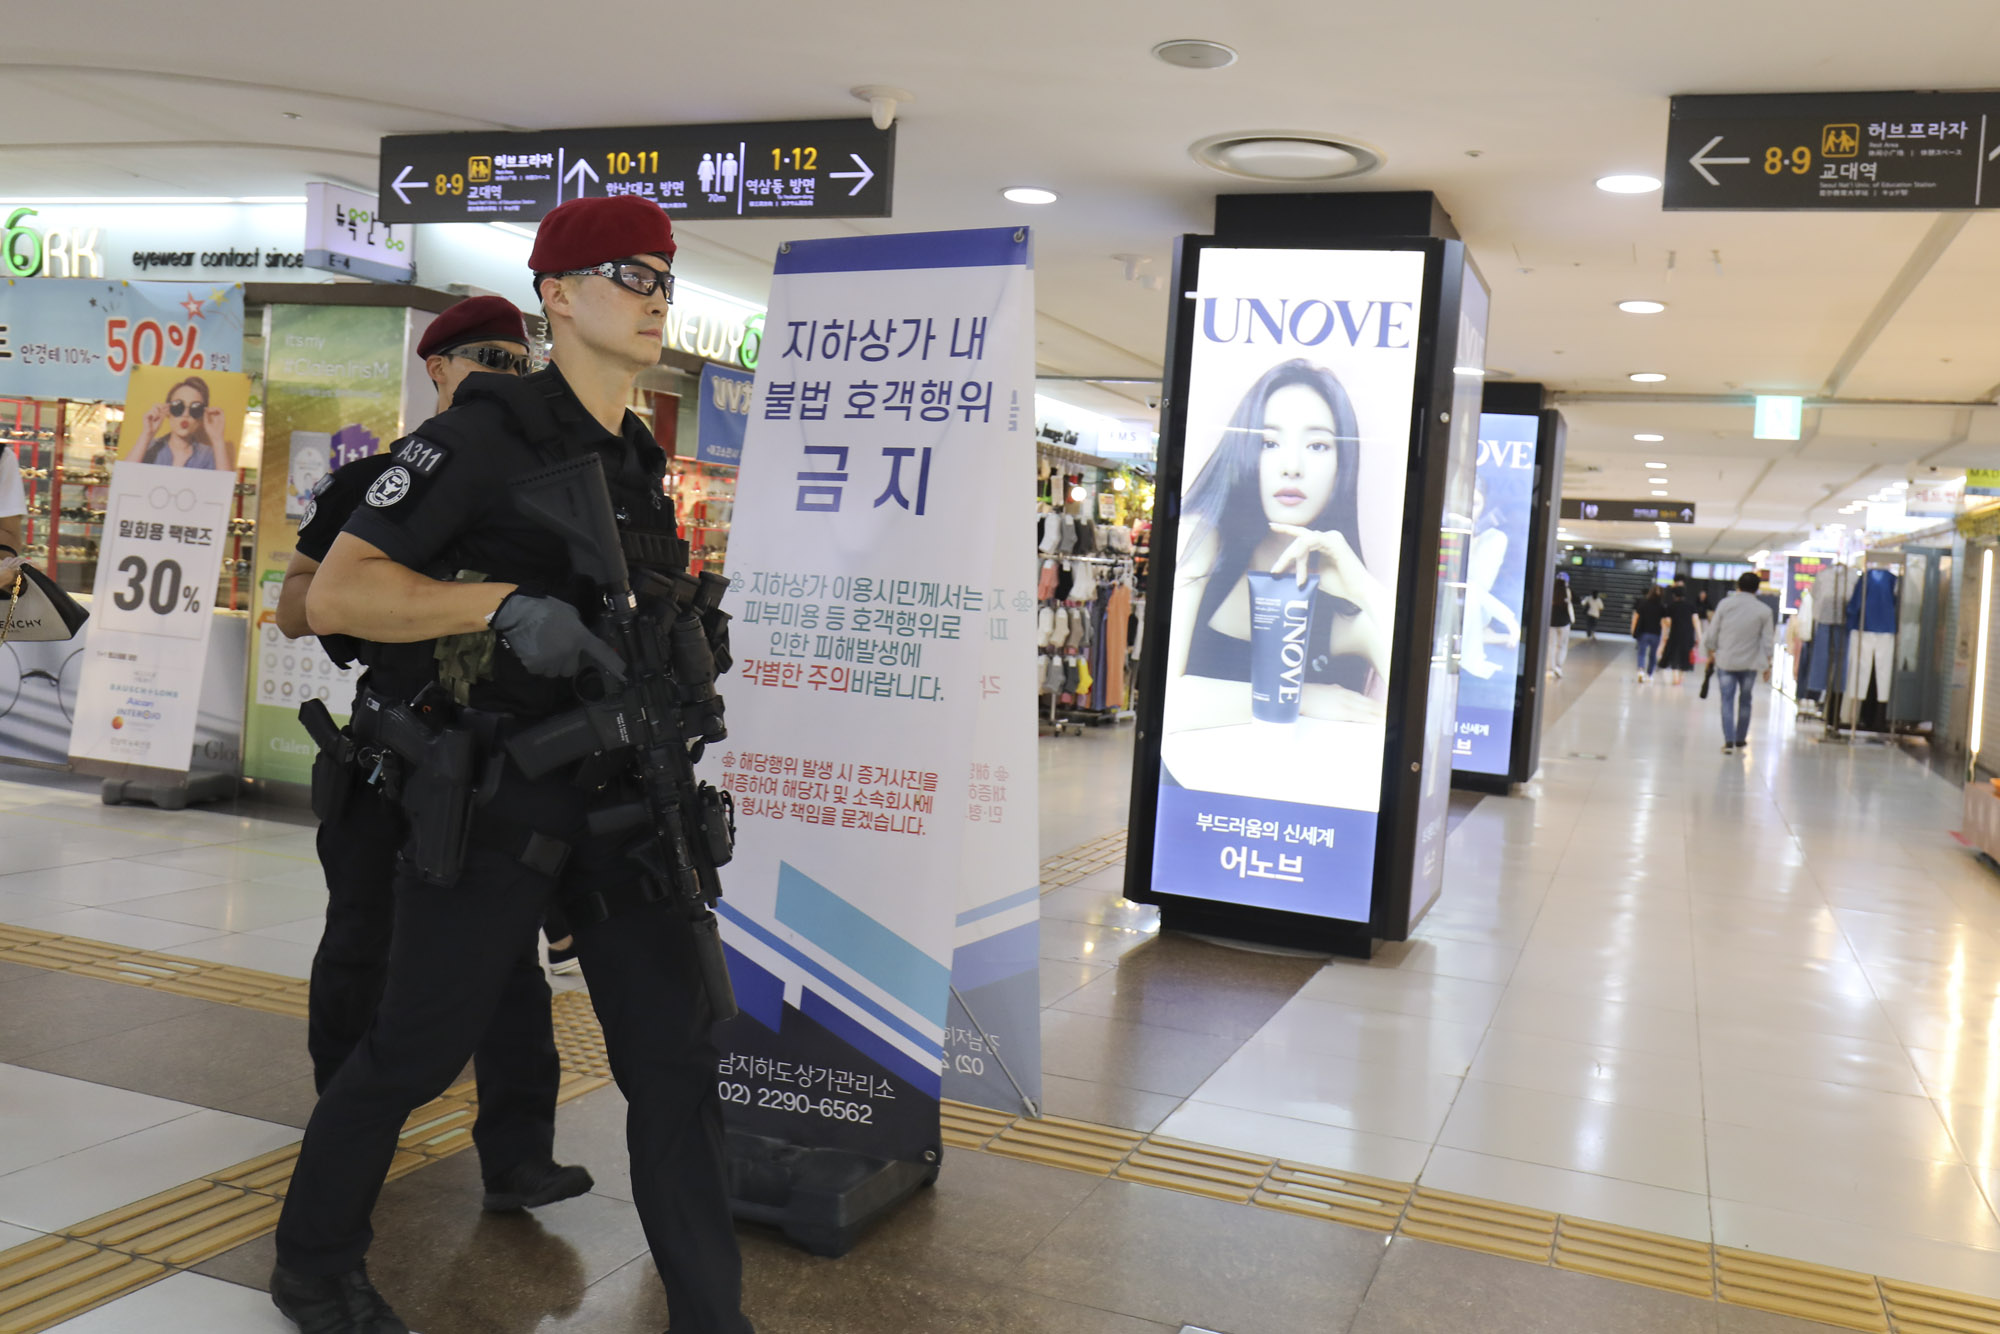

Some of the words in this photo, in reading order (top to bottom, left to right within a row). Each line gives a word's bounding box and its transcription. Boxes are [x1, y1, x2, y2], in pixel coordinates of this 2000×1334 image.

[1868, 121, 1968, 140] 허브프라자
[494, 153, 554, 168] 허브프라자
[1819, 162, 1877, 181] 교대역
[467, 185, 502, 199] 교대역
[605, 182, 656, 197] 한남대교
[660, 181, 685, 197] 방면
[707, 194, 727, 203] 70m
[745, 179, 785, 195] 역삼동
[789, 178, 815, 194] 방면
[132, 250, 195, 271] eyewear
[201, 246, 259, 268] contact
[264, 247, 303, 268] since
[329, 254, 350, 269] E-4
[781, 318, 936, 362] 지하상가
[949, 316, 987, 360] 내
[1203, 297, 1413, 349] UNOVE
[20, 343, 60, 365] 안경테
[107, 318, 204, 372] 50%
[764, 381, 831, 421] 불법
[843, 379, 993, 423] 호객행위
[337, 443, 369, 466] 1+1
[397, 440, 442, 472] A311
[119, 519, 165, 541] 일회용
[169, 524, 213, 546] 팩렌즈
[113, 555, 201, 615] 30%
[750, 571, 828, 600] 지하상가
[832, 575, 984, 612] 이용시민께서는
[742, 600, 820, 629] 피부미용
[825, 605, 847, 632] 등
[850, 607, 962, 641] 호객행위로
[769, 631, 809, 659] 인한
[813, 634, 922, 669] 피해발생에
[1278, 600, 1309, 704] UNOVE
[741, 659, 803, 690] 각별한
[806, 664, 945, 702] 주의바랍니다.
[739, 751, 799, 777] 해당행위
[802, 758, 834, 782] 발생
[836, 762, 854, 784] 시
[857, 764, 939, 793] 증거사진을
[720, 770, 779, 797] 채증하여
[782, 778, 830, 803] 해당자
[833, 784, 849, 805] 및
[852, 787, 934, 815] 소속회사에
[790, 801, 837, 827] 책임을
[841, 807, 927, 837] 묻겠습니다.
[1195, 812, 1280, 842] 부드러움의
[1283, 823, 1335, 849] 신세계
[1219, 846, 1304, 883] 어노브
[718, 1081, 752, 1106] 02)
[757, 1088, 874, 1126] 2290-6562
